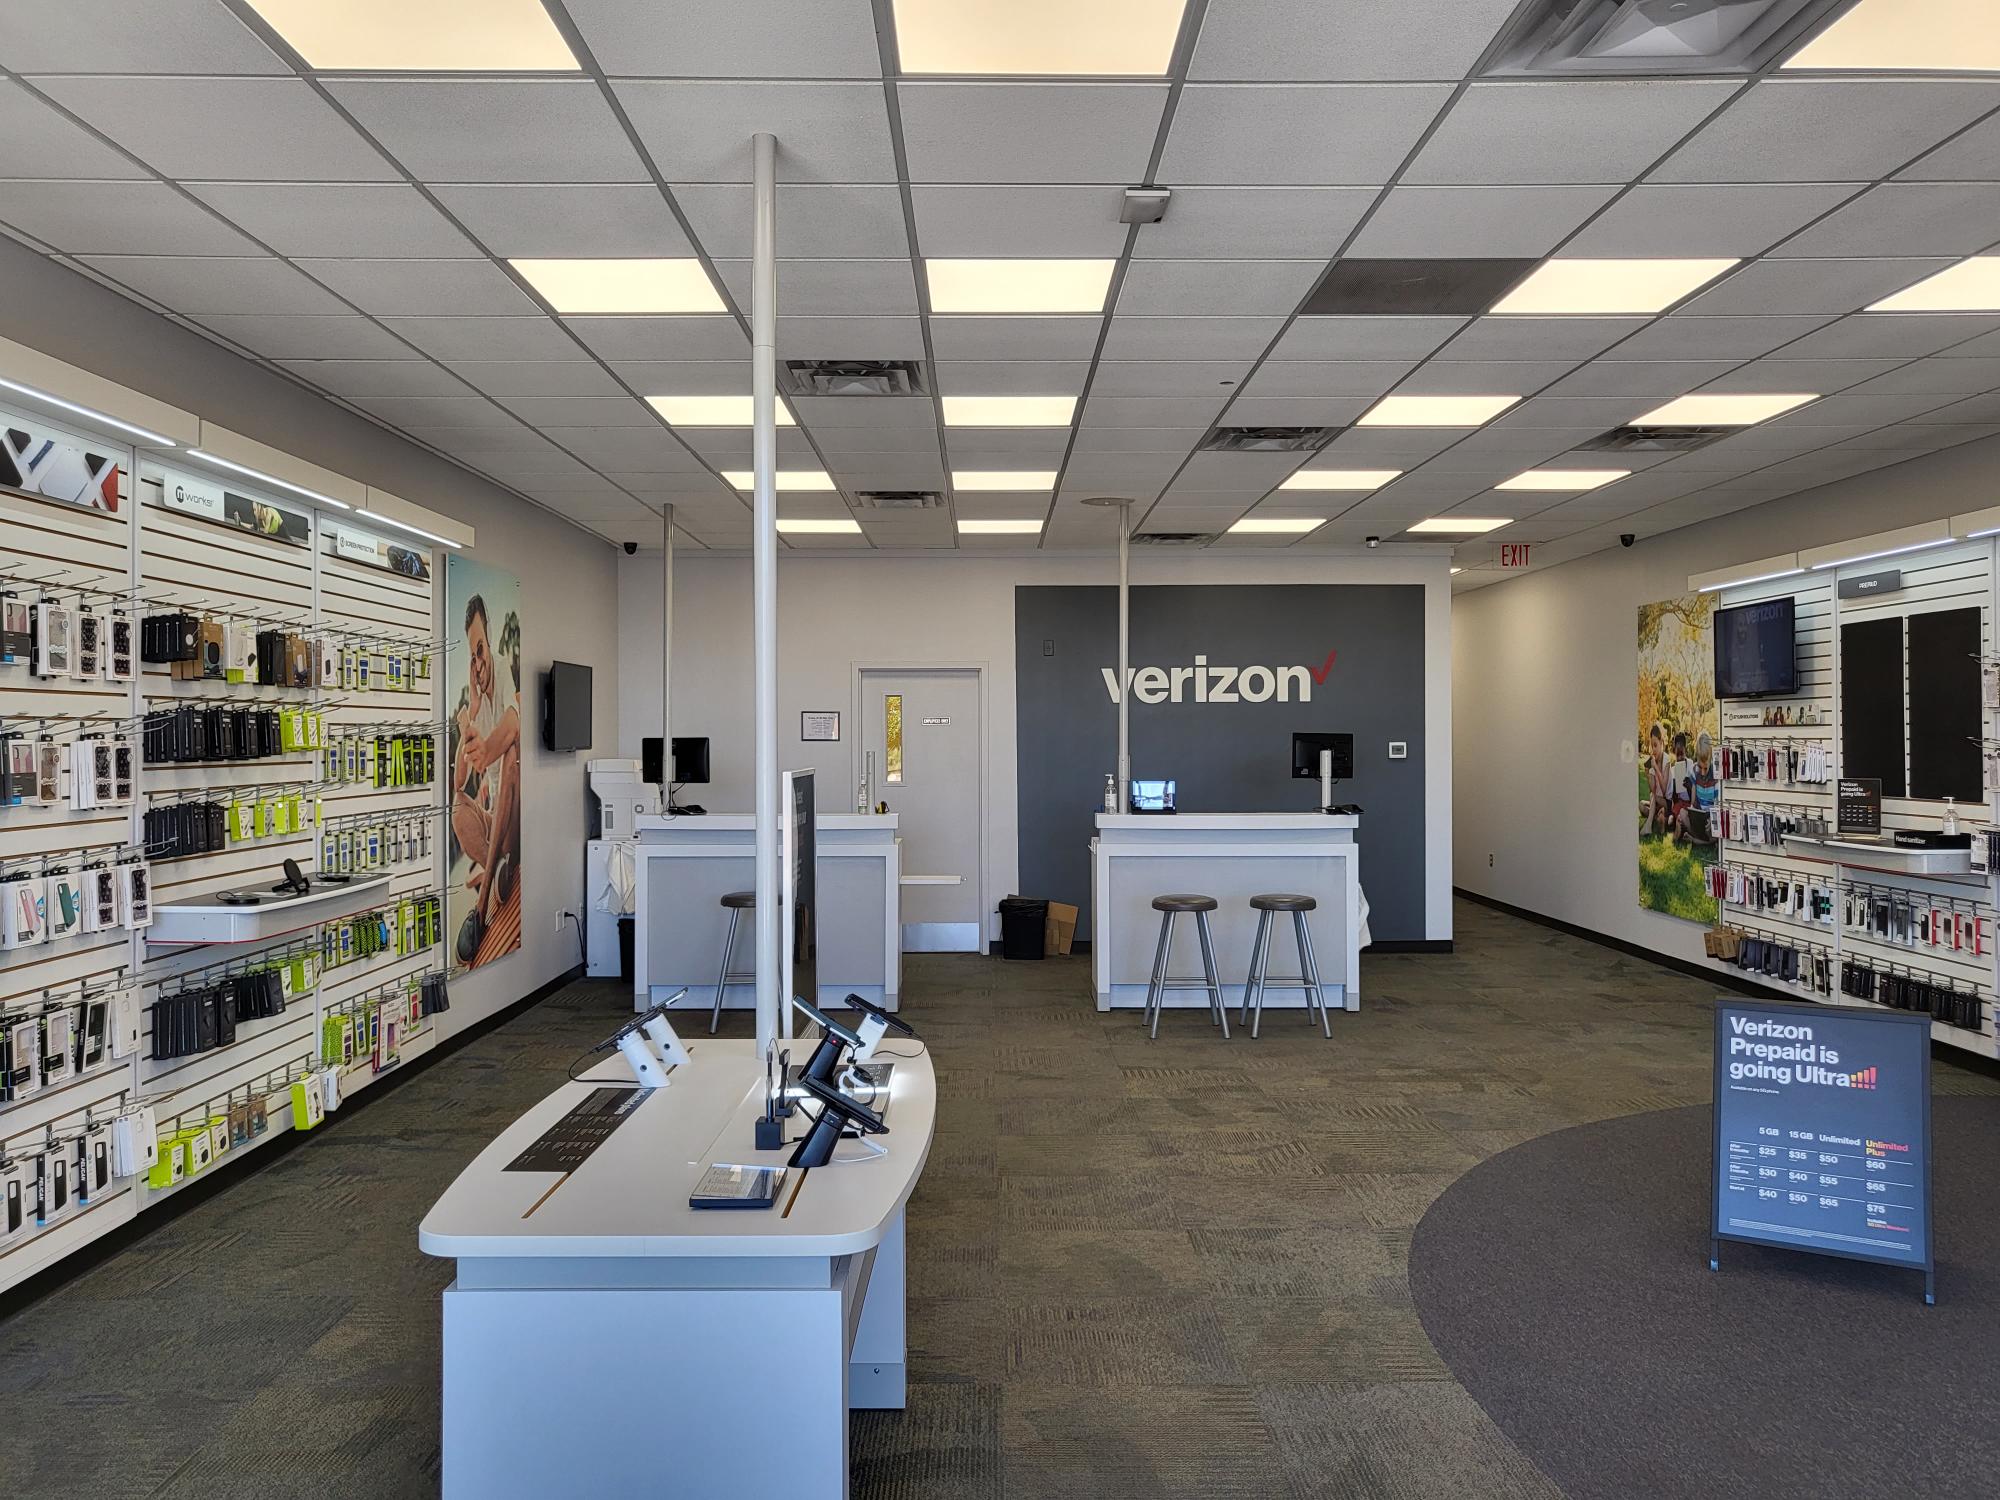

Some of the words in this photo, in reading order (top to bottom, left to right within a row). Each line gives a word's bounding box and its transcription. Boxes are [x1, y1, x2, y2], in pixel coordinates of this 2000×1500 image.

[1501, 545, 1531, 566] EXIT
[1101, 655, 1312, 704] verizon
[1730, 1016, 1812, 1041] Verizon
[1730, 1037, 1816, 1063] Prepaid
[1819, 1045, 1840, 1064] is
[1729, 1060, 1792, 1085] going
[1759, 1127, 1766, 1135] 5
[1766, 1128, 1779, 1136] GB
[1789, 1131, 1799, 1139] 15
[1800, 1132, 1814, 1140] GB
[1819, 1134, 1861, 1146] Unlimited
[1866, 1139, 1909, 1152] Unlimited
[1759, 1146, 1776, 1156] $25
[1788, 1150, 1807, 1160] $35
[1819, 1154, 1838, 1164] $50
[1866, 1148, 1886, 1157] Plus
[1759, 1167, 1777, 1177] $30
[1788, 1171, 1808, 1181] $40
[1819, 1175, 1838, 1185] $55
[1758, 1188, 1777, 1198] $40
[1788, 1193, 1808, 1203] $50
[1866, 1203, 1886, 1214] $75
